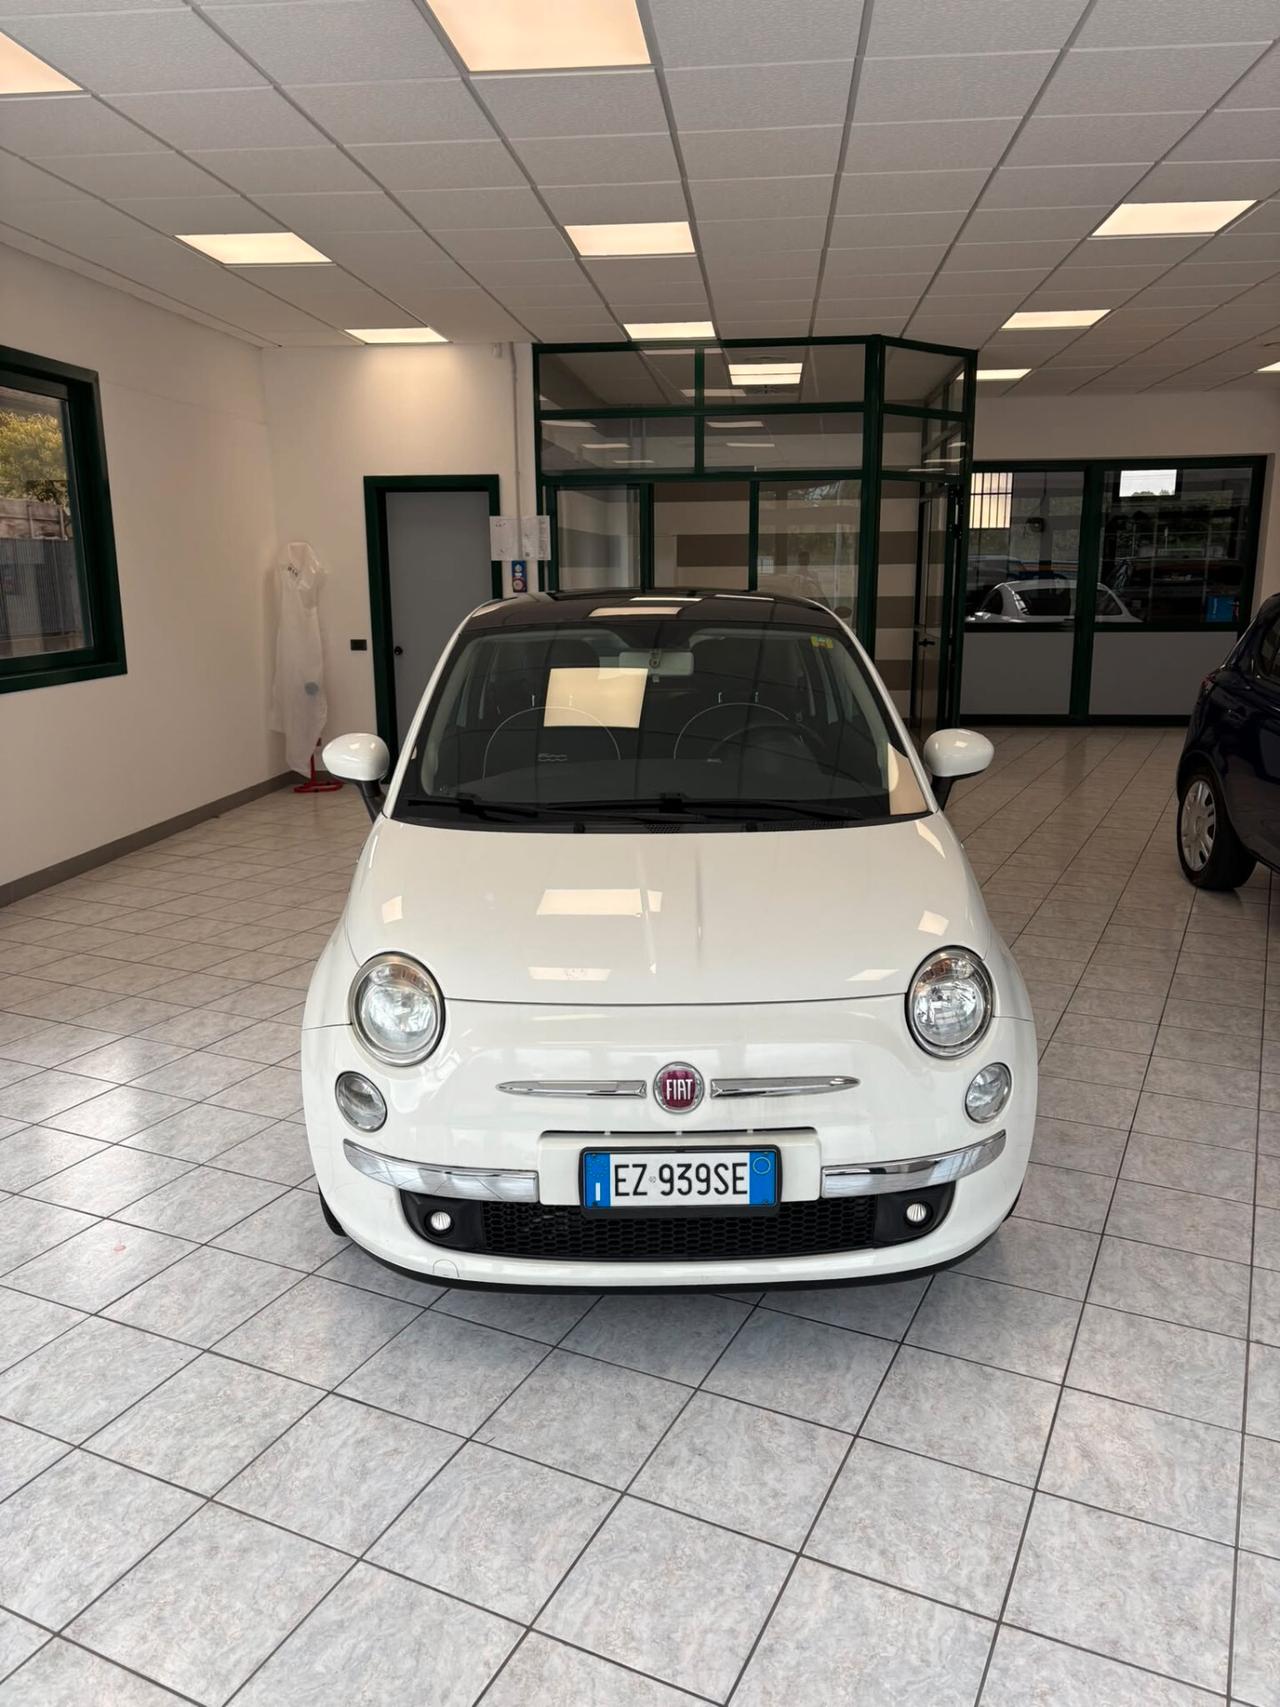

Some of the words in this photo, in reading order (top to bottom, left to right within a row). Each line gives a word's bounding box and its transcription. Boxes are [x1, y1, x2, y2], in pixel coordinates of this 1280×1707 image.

[666, 1079, 693, 1100] FIAT
[614, 1163, 648, 1197] EZ
[658, 1162, 748, 1196] 939SE
